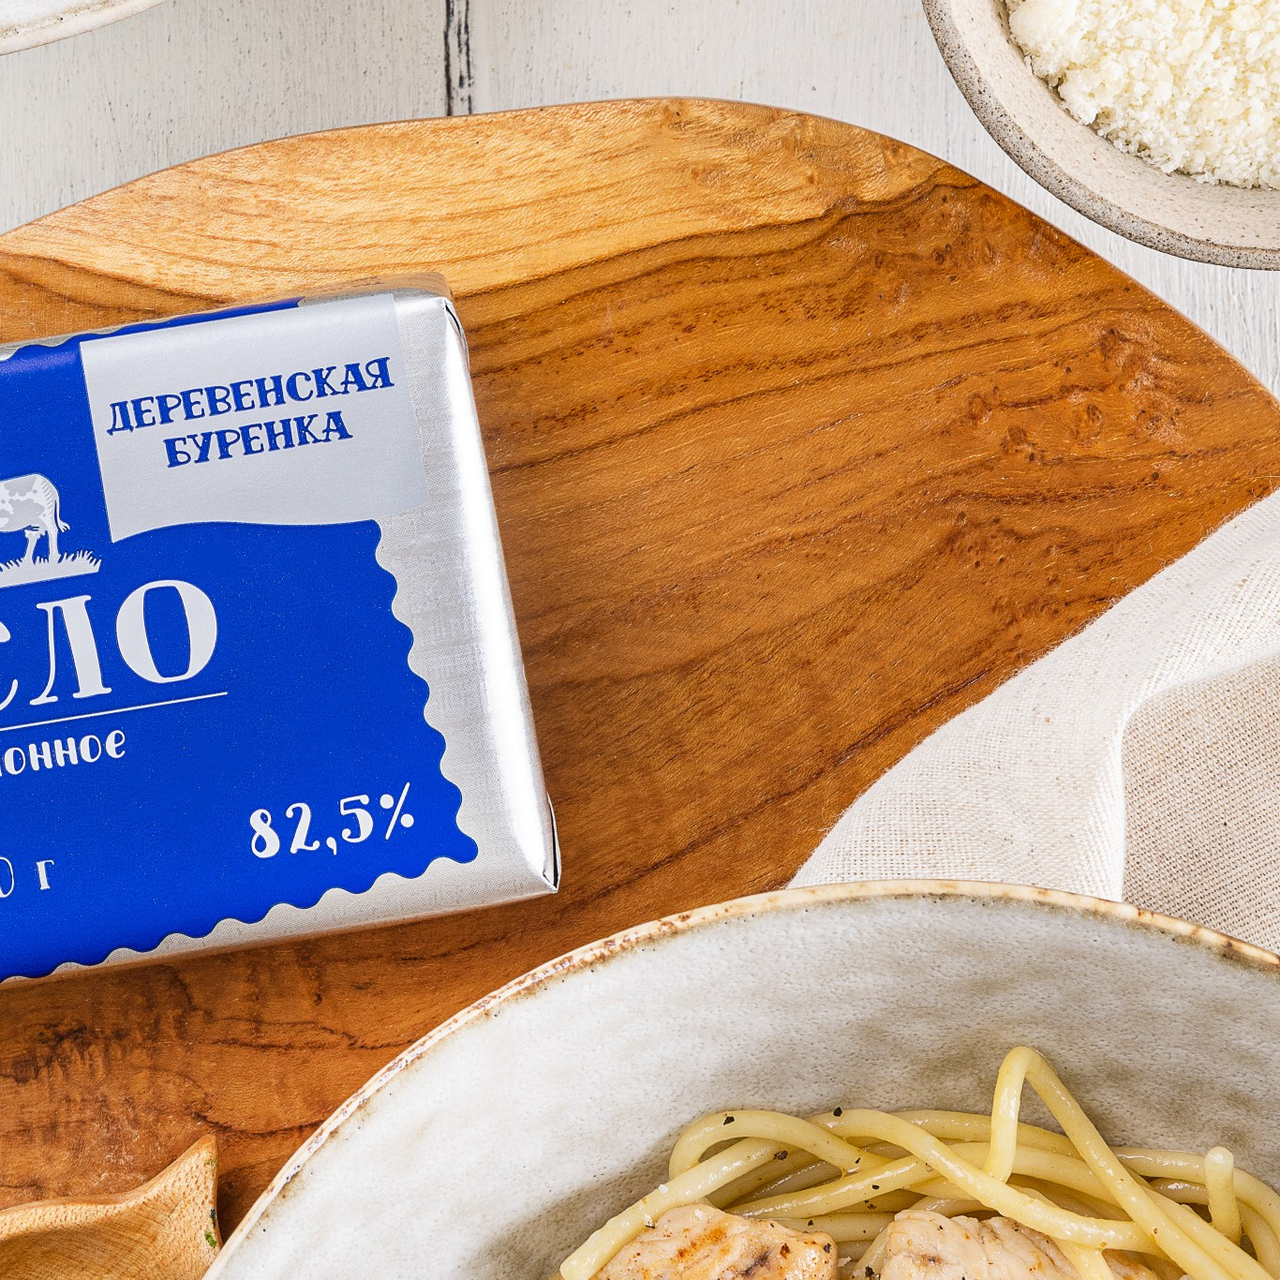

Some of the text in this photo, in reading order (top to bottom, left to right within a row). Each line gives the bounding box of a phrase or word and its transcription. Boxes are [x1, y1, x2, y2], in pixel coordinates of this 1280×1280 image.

[106, 356, 395, 436] ДЕРЕВЕНСКАЯ
[163, 410, 353, 468] БУРЕНКА
[249, 782, 415, 859] 82,5%
[36, 859, 54, 891] г
